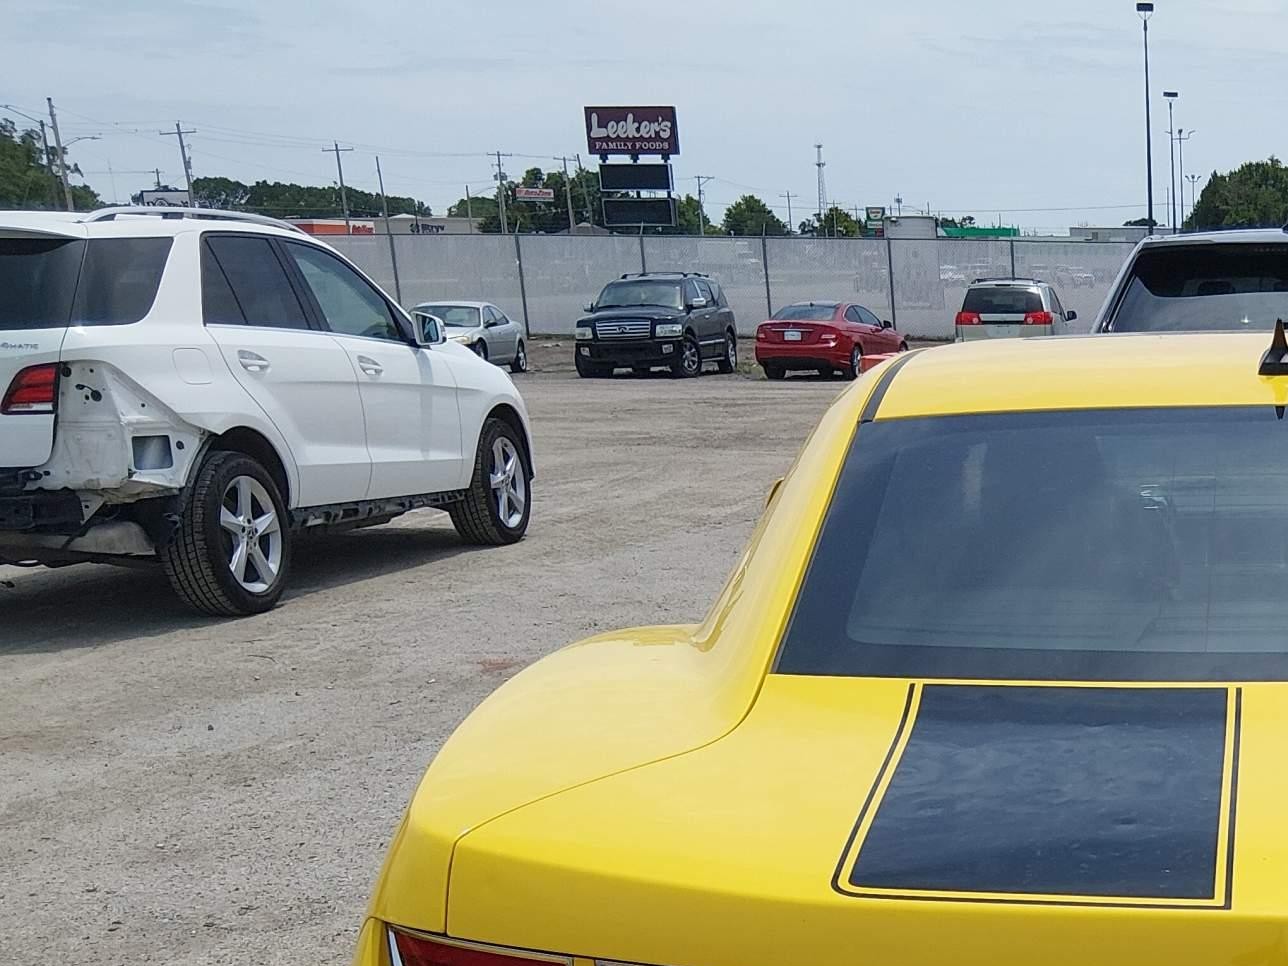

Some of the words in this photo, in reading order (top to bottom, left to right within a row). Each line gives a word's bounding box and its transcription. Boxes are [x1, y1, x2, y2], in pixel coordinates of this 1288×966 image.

[590, 112, 672, 139] Leeker's
[595, 141, 633, 150] FAMILY
[635, 141, 669, 150] FOODS
